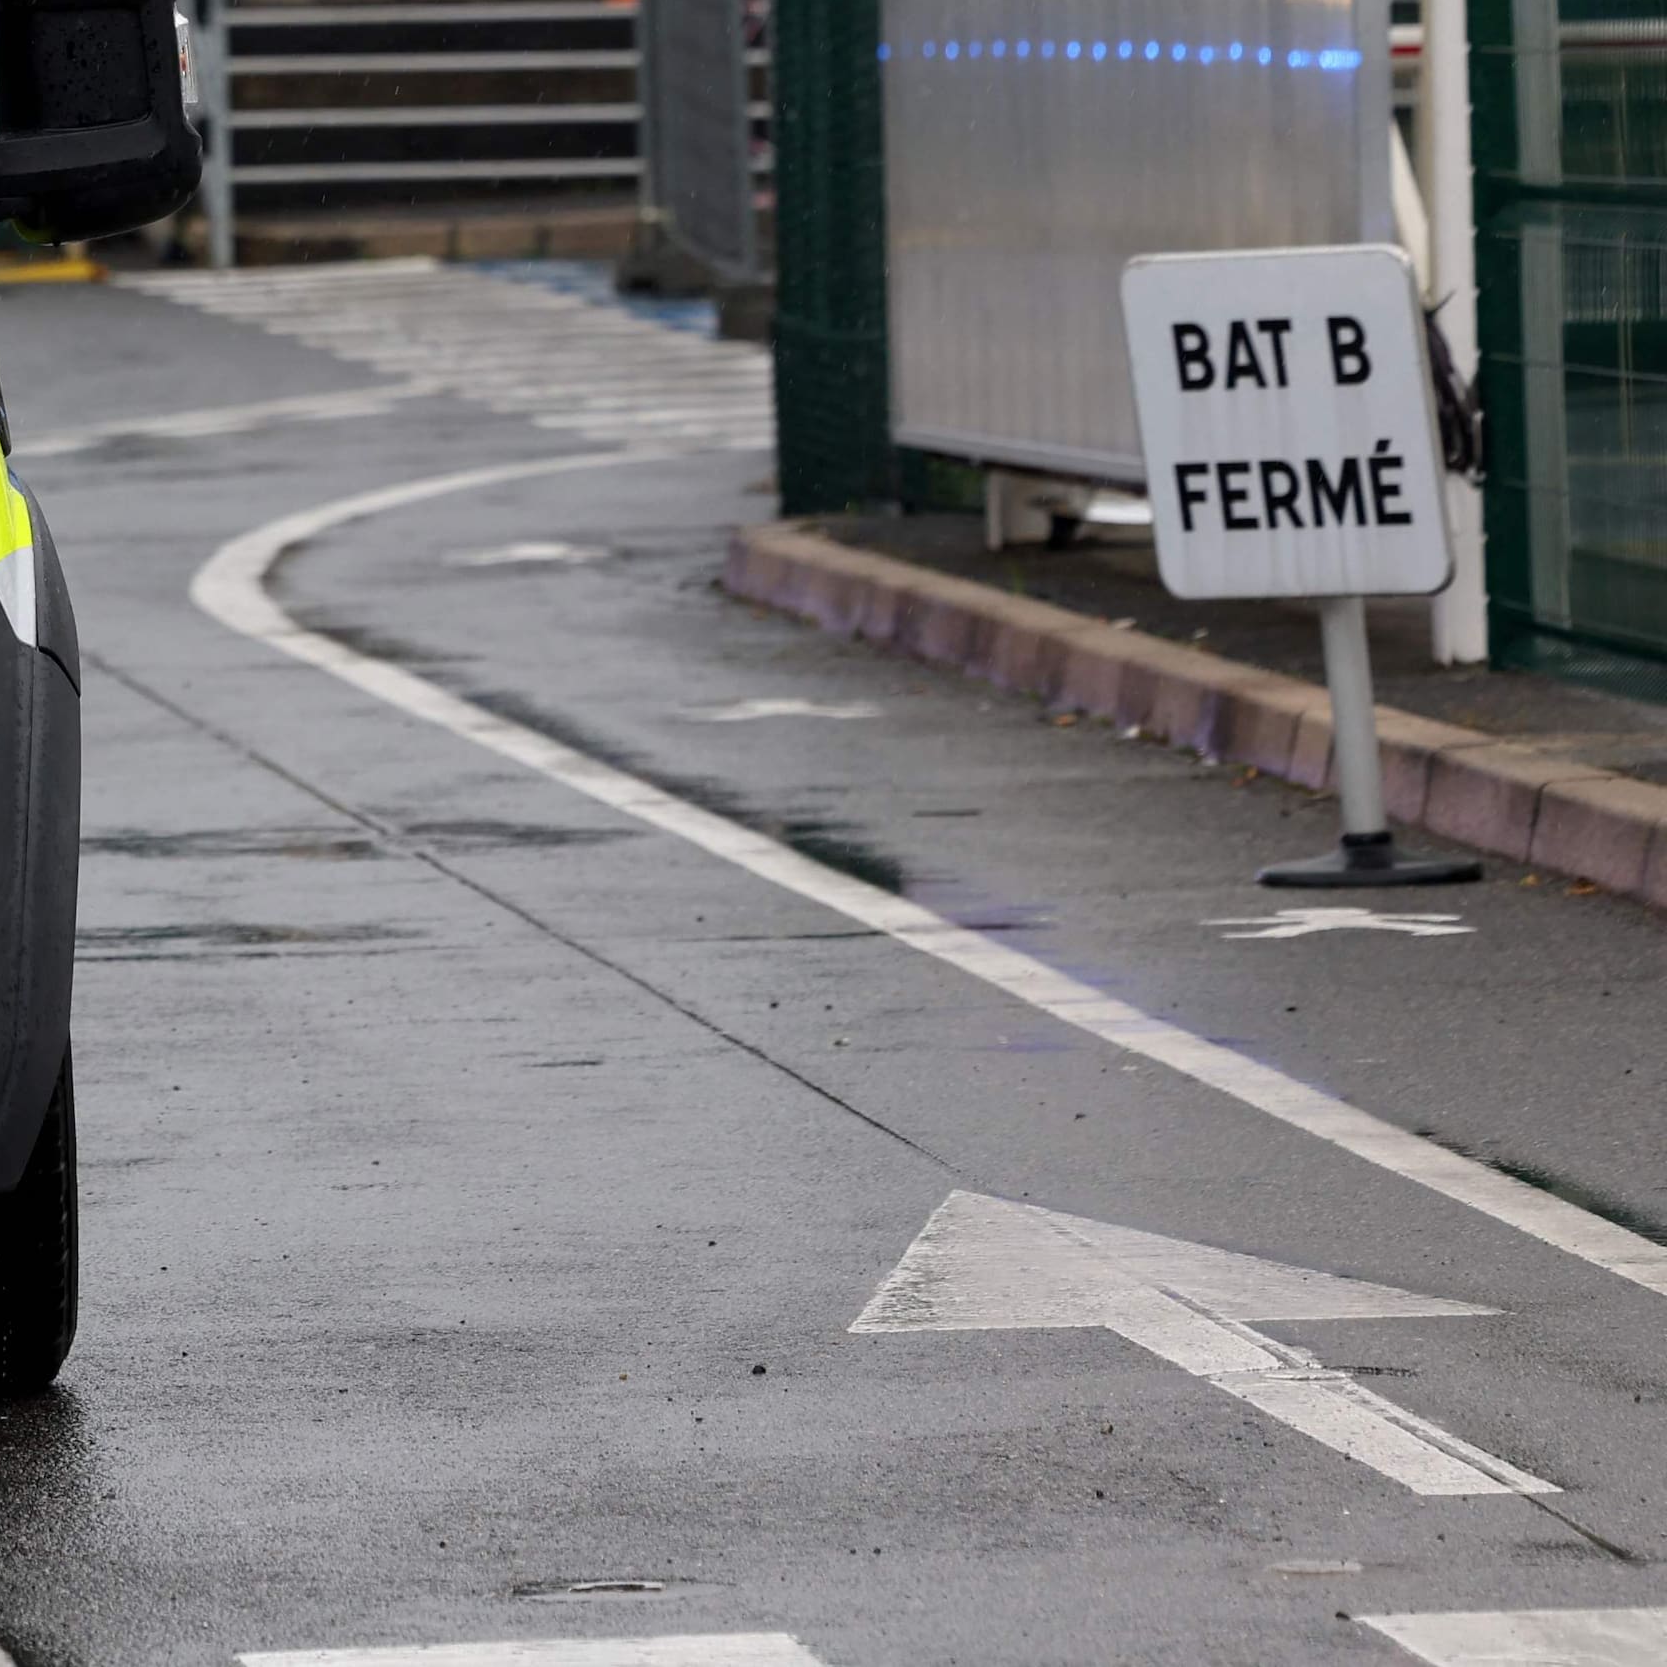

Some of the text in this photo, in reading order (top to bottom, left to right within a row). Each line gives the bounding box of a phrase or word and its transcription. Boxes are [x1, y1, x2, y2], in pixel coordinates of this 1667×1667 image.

[1171, 315, 1373, 392] BAT B
[1174, 438, 1414, 533] FERMÉ
